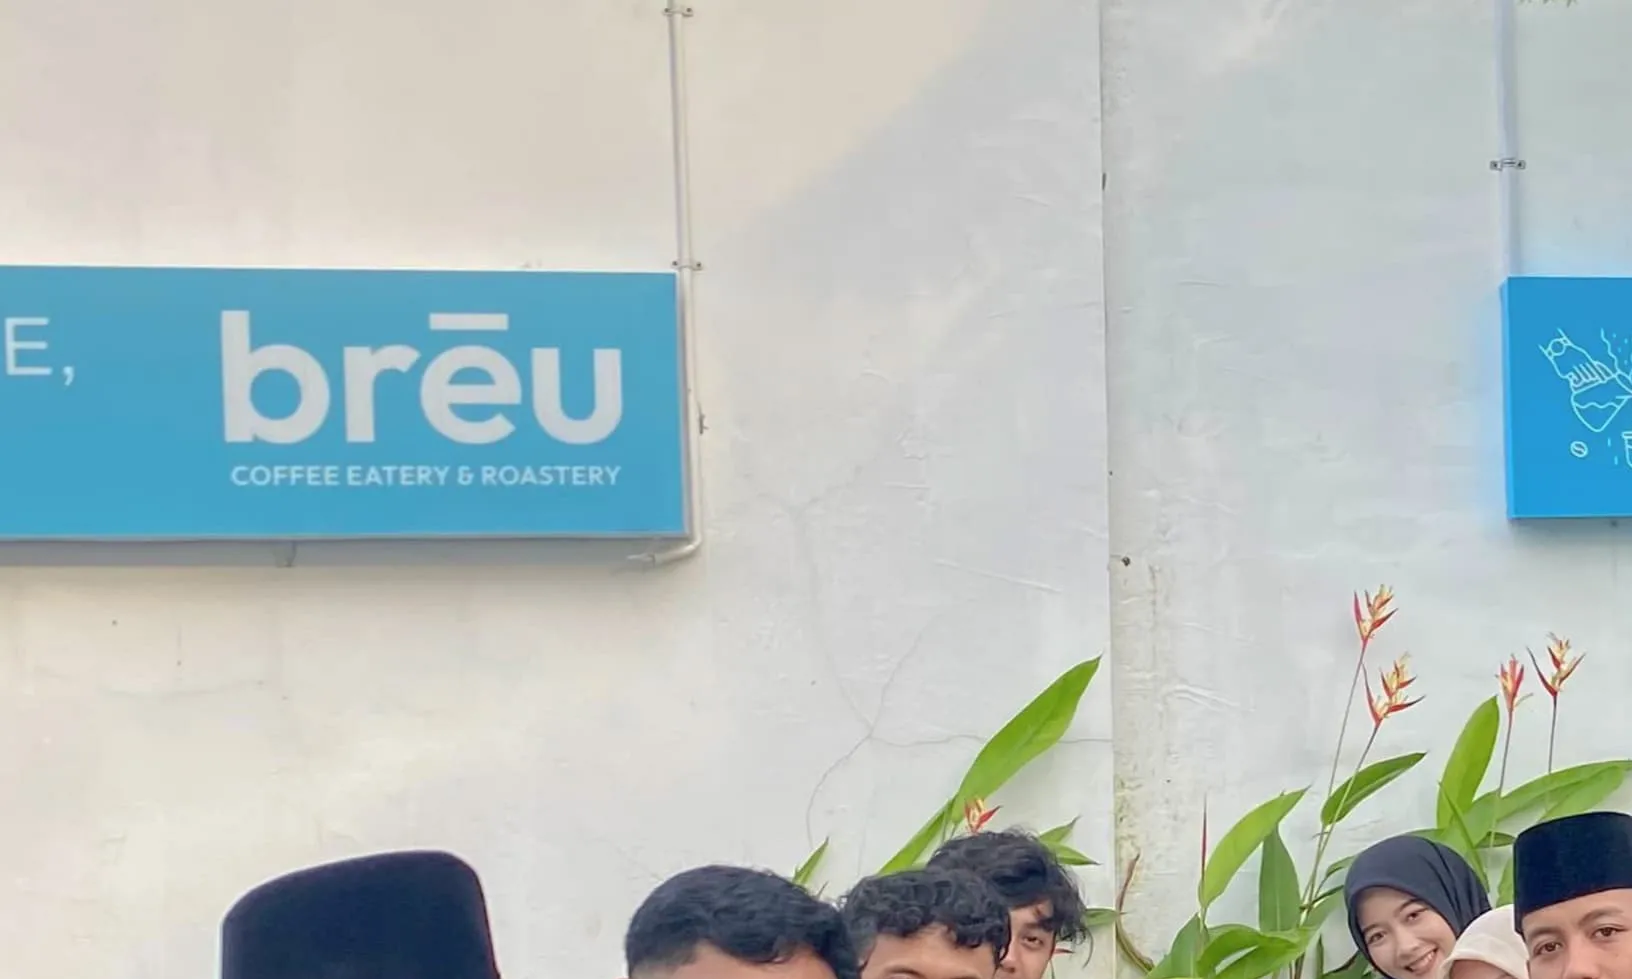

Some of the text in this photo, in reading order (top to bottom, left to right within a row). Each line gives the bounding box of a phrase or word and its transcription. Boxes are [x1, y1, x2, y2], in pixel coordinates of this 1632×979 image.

[220, 309, 624, 444] brēu
[231, 465, 622, 486] COFFEE EATERY & ROASTERY
